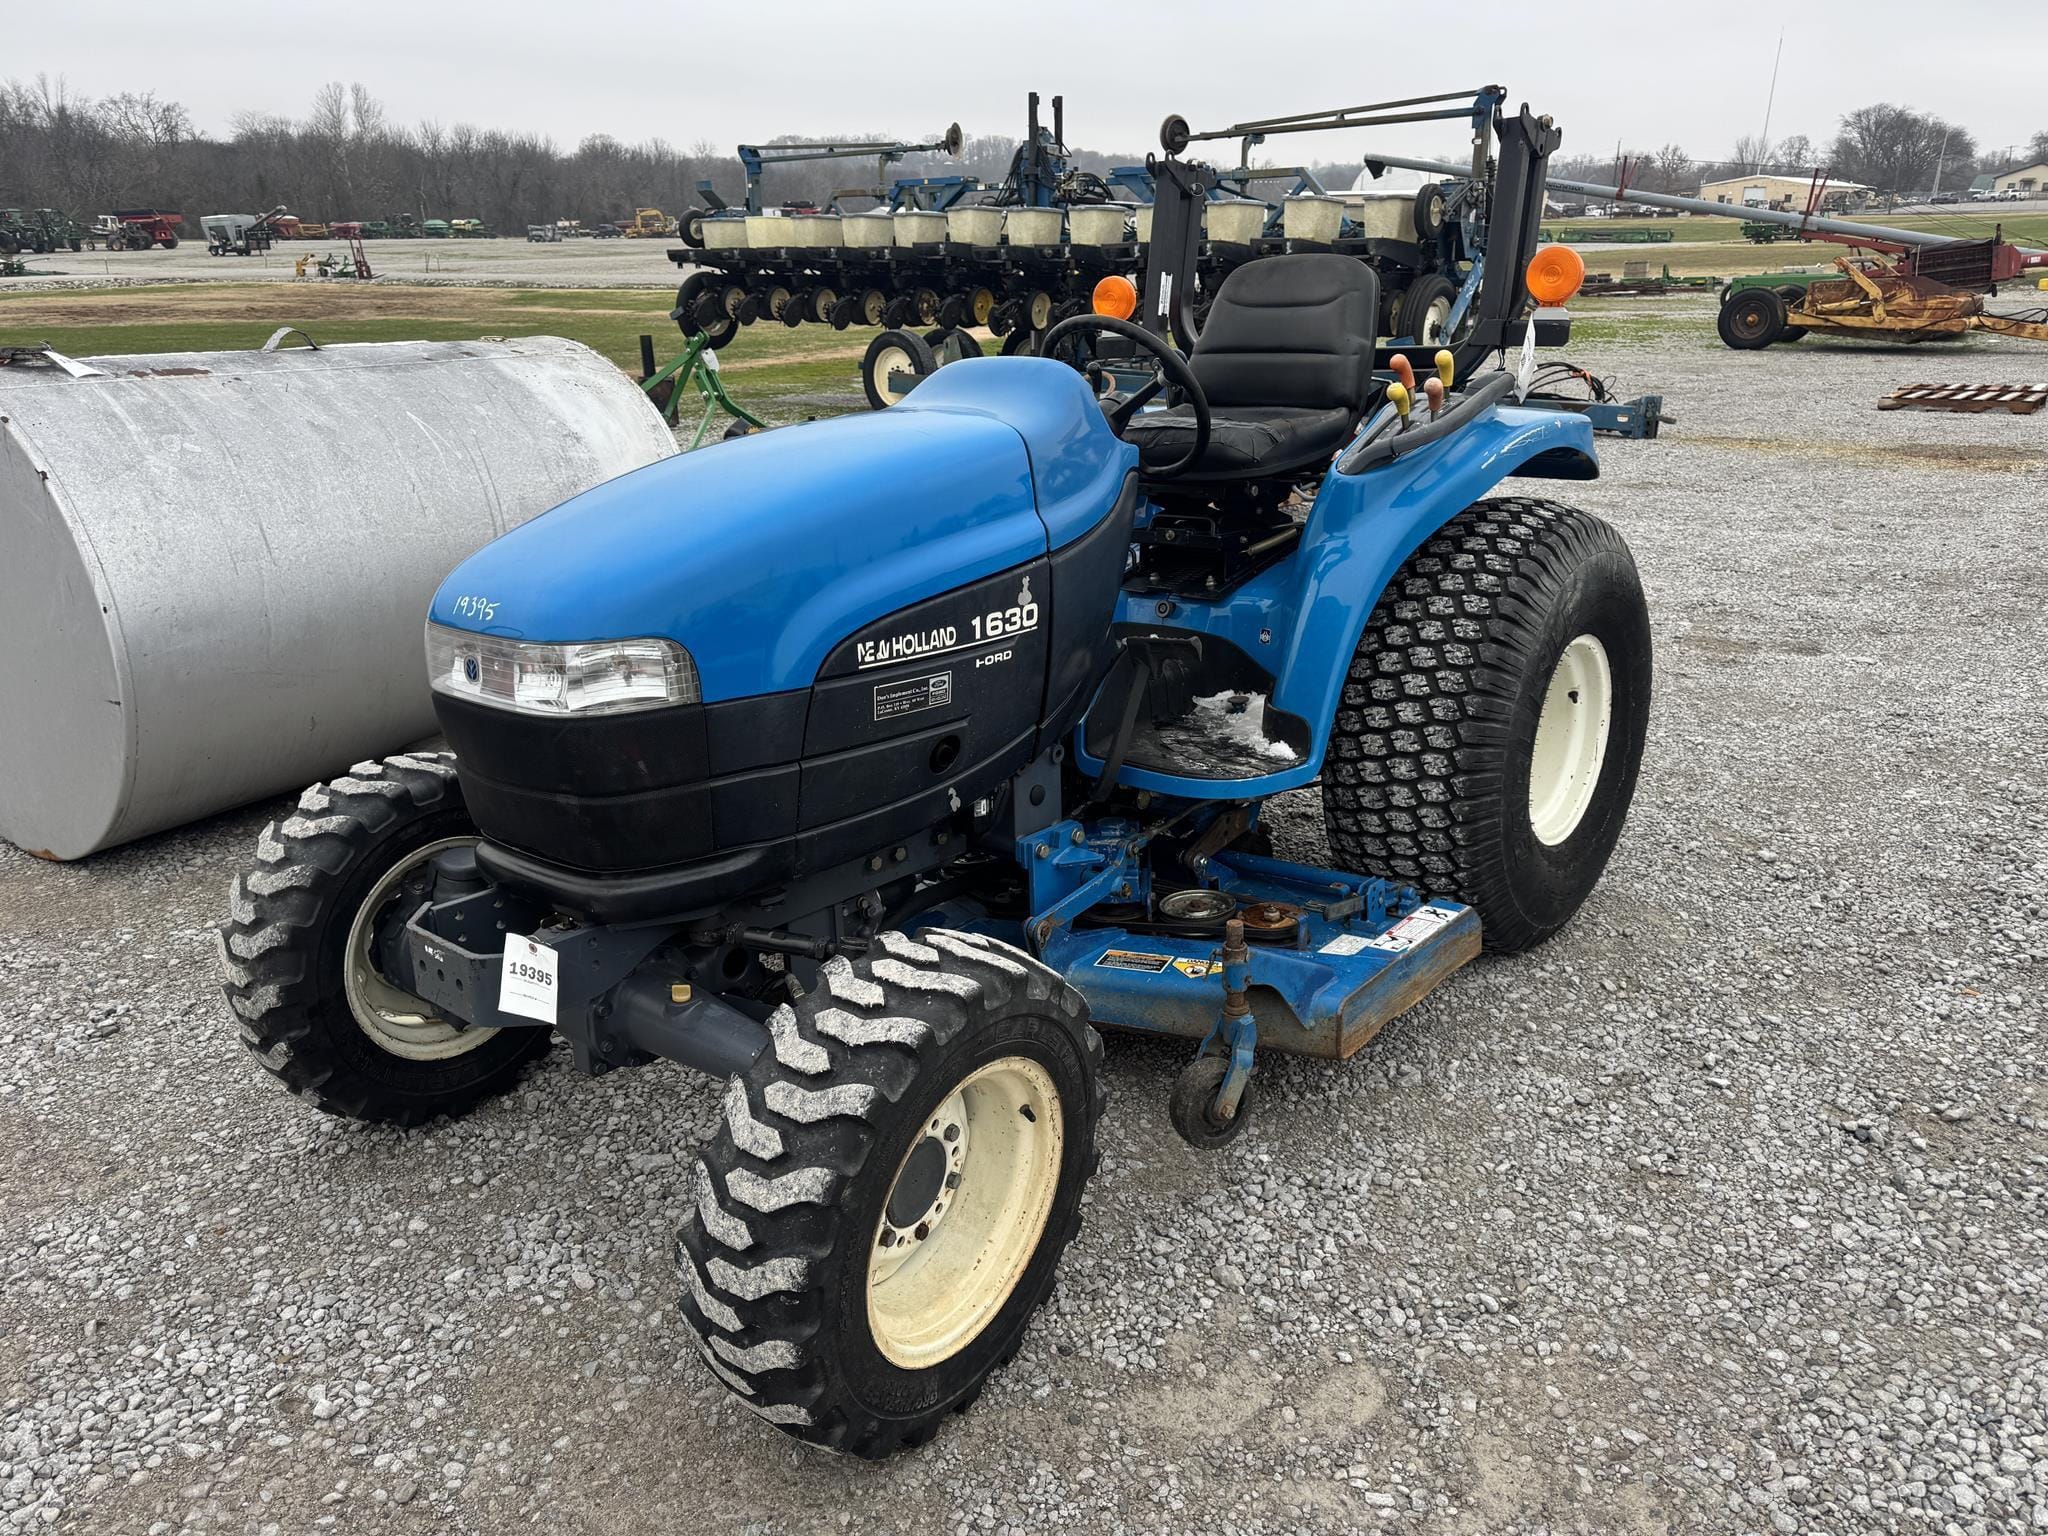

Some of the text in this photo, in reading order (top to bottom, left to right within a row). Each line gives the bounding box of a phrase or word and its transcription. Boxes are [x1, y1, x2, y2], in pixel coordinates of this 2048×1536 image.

[453, 596, 501, 621] 19395
[892, 627, 957, 657] HOLLAND
[971, 602, 1039, 640] 1630
[509, 961, 553, 986] 19395
